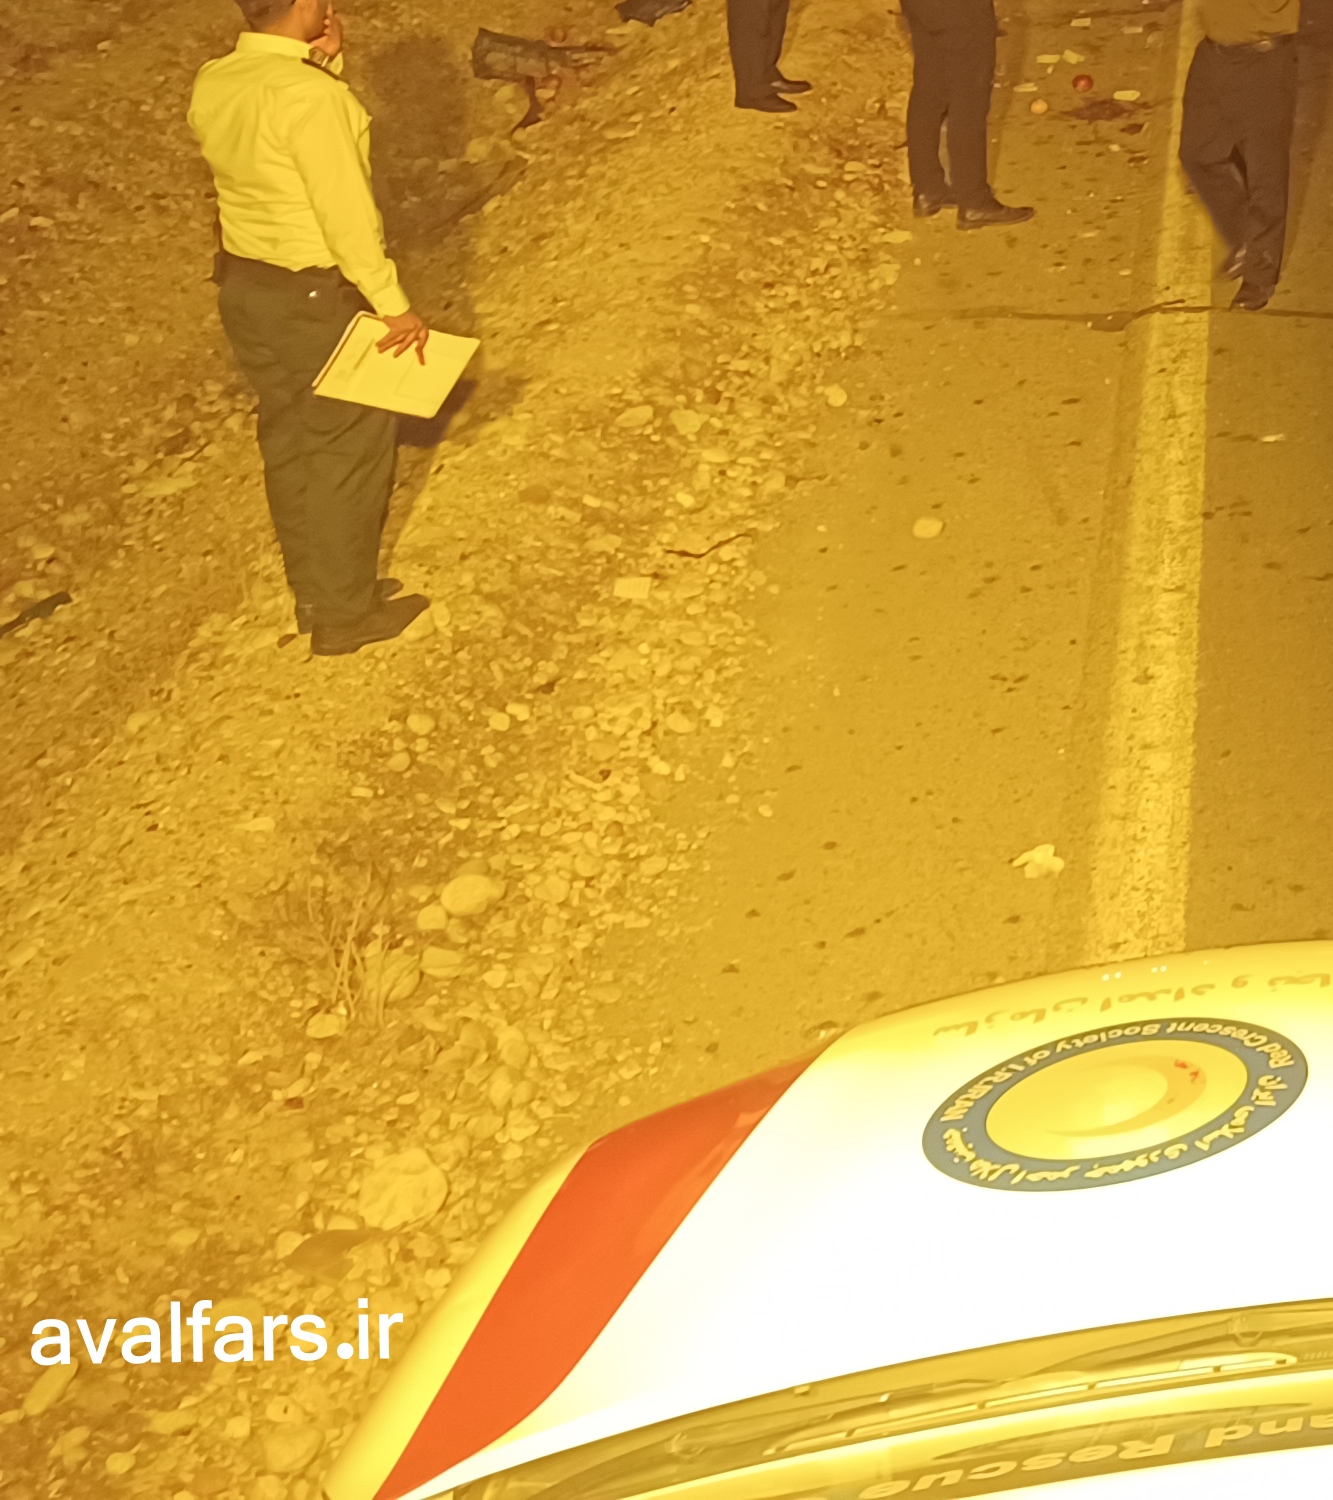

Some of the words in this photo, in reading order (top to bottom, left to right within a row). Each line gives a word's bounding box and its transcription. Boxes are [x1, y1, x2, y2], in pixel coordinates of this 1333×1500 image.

[932, 996, 1089, 1038] سازمان
[1099, 982, 1217, 1013] امداد
[1055, 1023, 1162, 1054] Society
[1165, 1021, 1268, 1048] Crescent
[1023, 1048, 1051, 1068] of
[1255, 1042, 1295, 1070] Red
[857, 1433, 1177, 1500] Rescue
